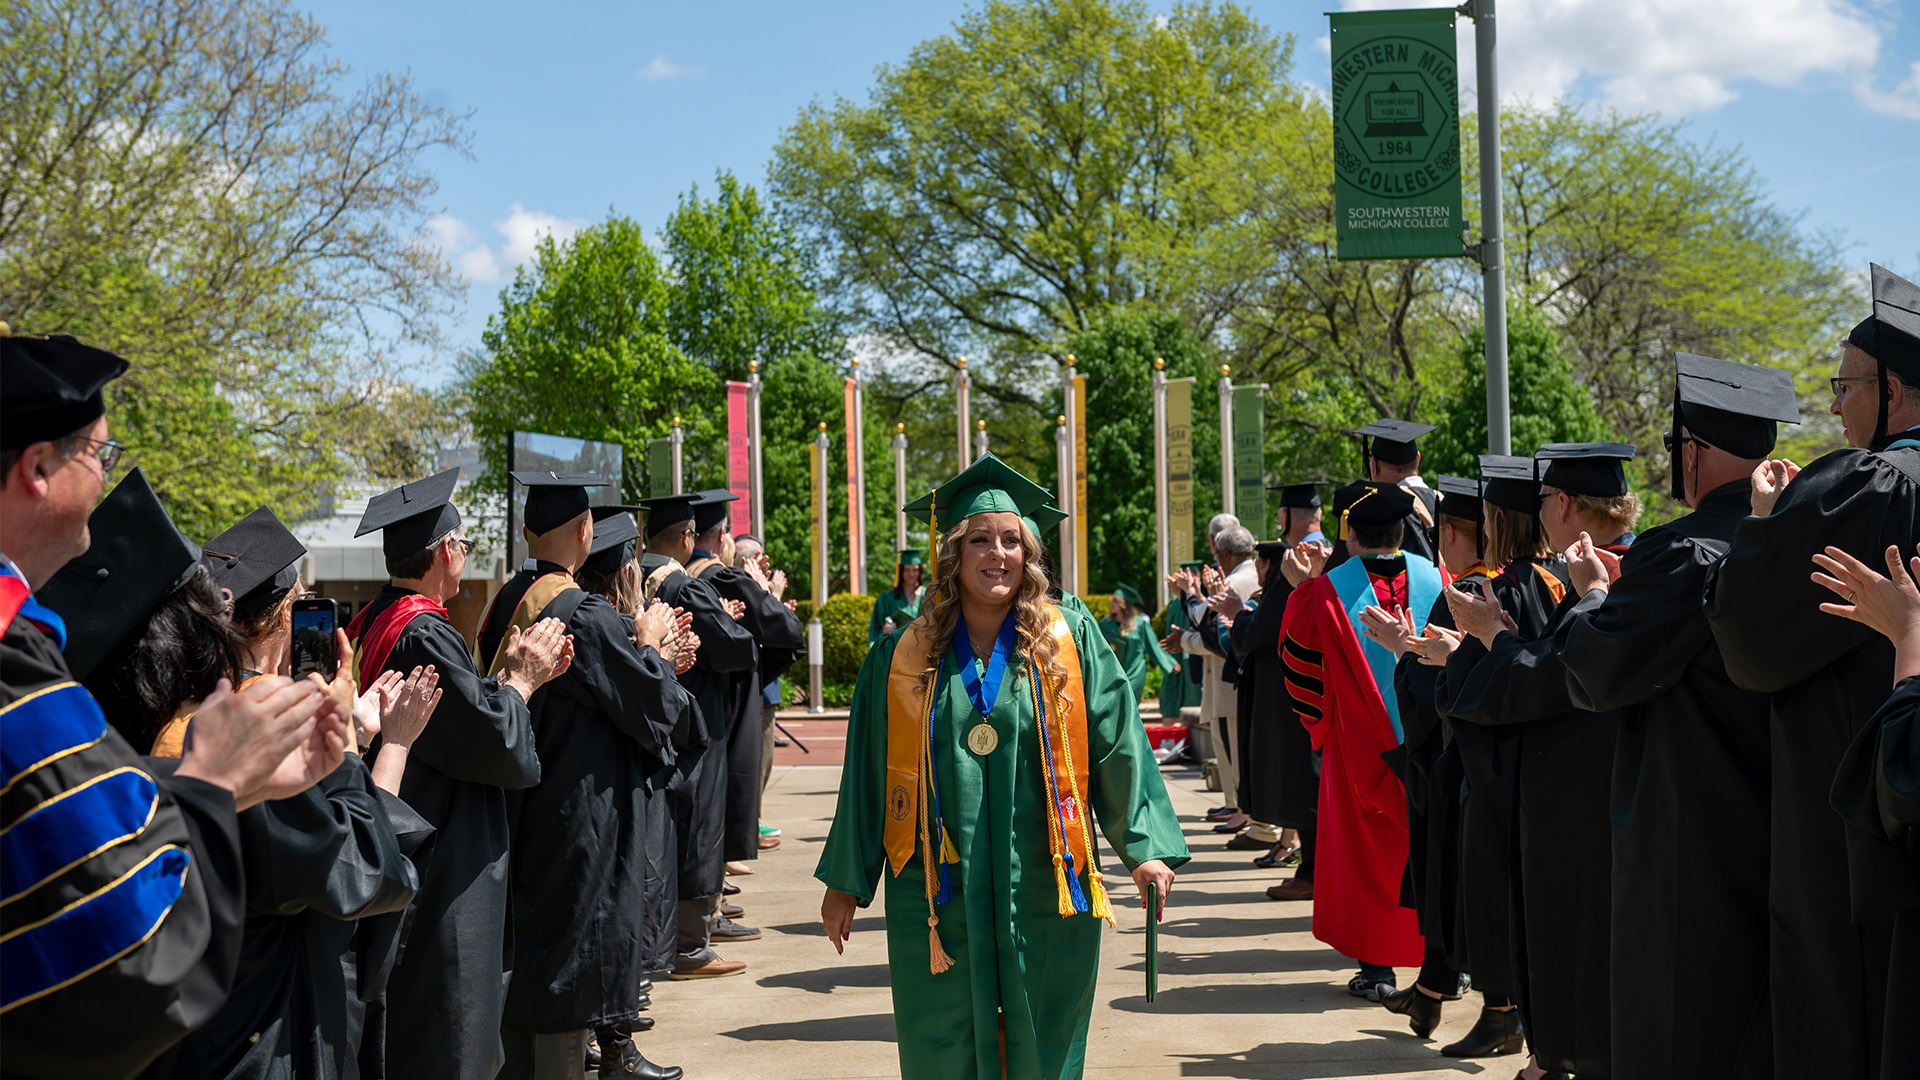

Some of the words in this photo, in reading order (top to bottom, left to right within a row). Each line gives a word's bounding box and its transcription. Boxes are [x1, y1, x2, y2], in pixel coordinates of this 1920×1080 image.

[1373, 97, 1415, 106] KNOWLEDGE
[1396, 108, 1409, 116] ALL
[1378, 140, 1413, 156] 1964
[1357, 164, 1440, 193] COLLEGE
[1347, 206, 1451, 219] SOUTHWESTERN
[1348, 219, 1402, 230] MICHIGAN
[1403, 218, 1450, 229] COLLEGE
